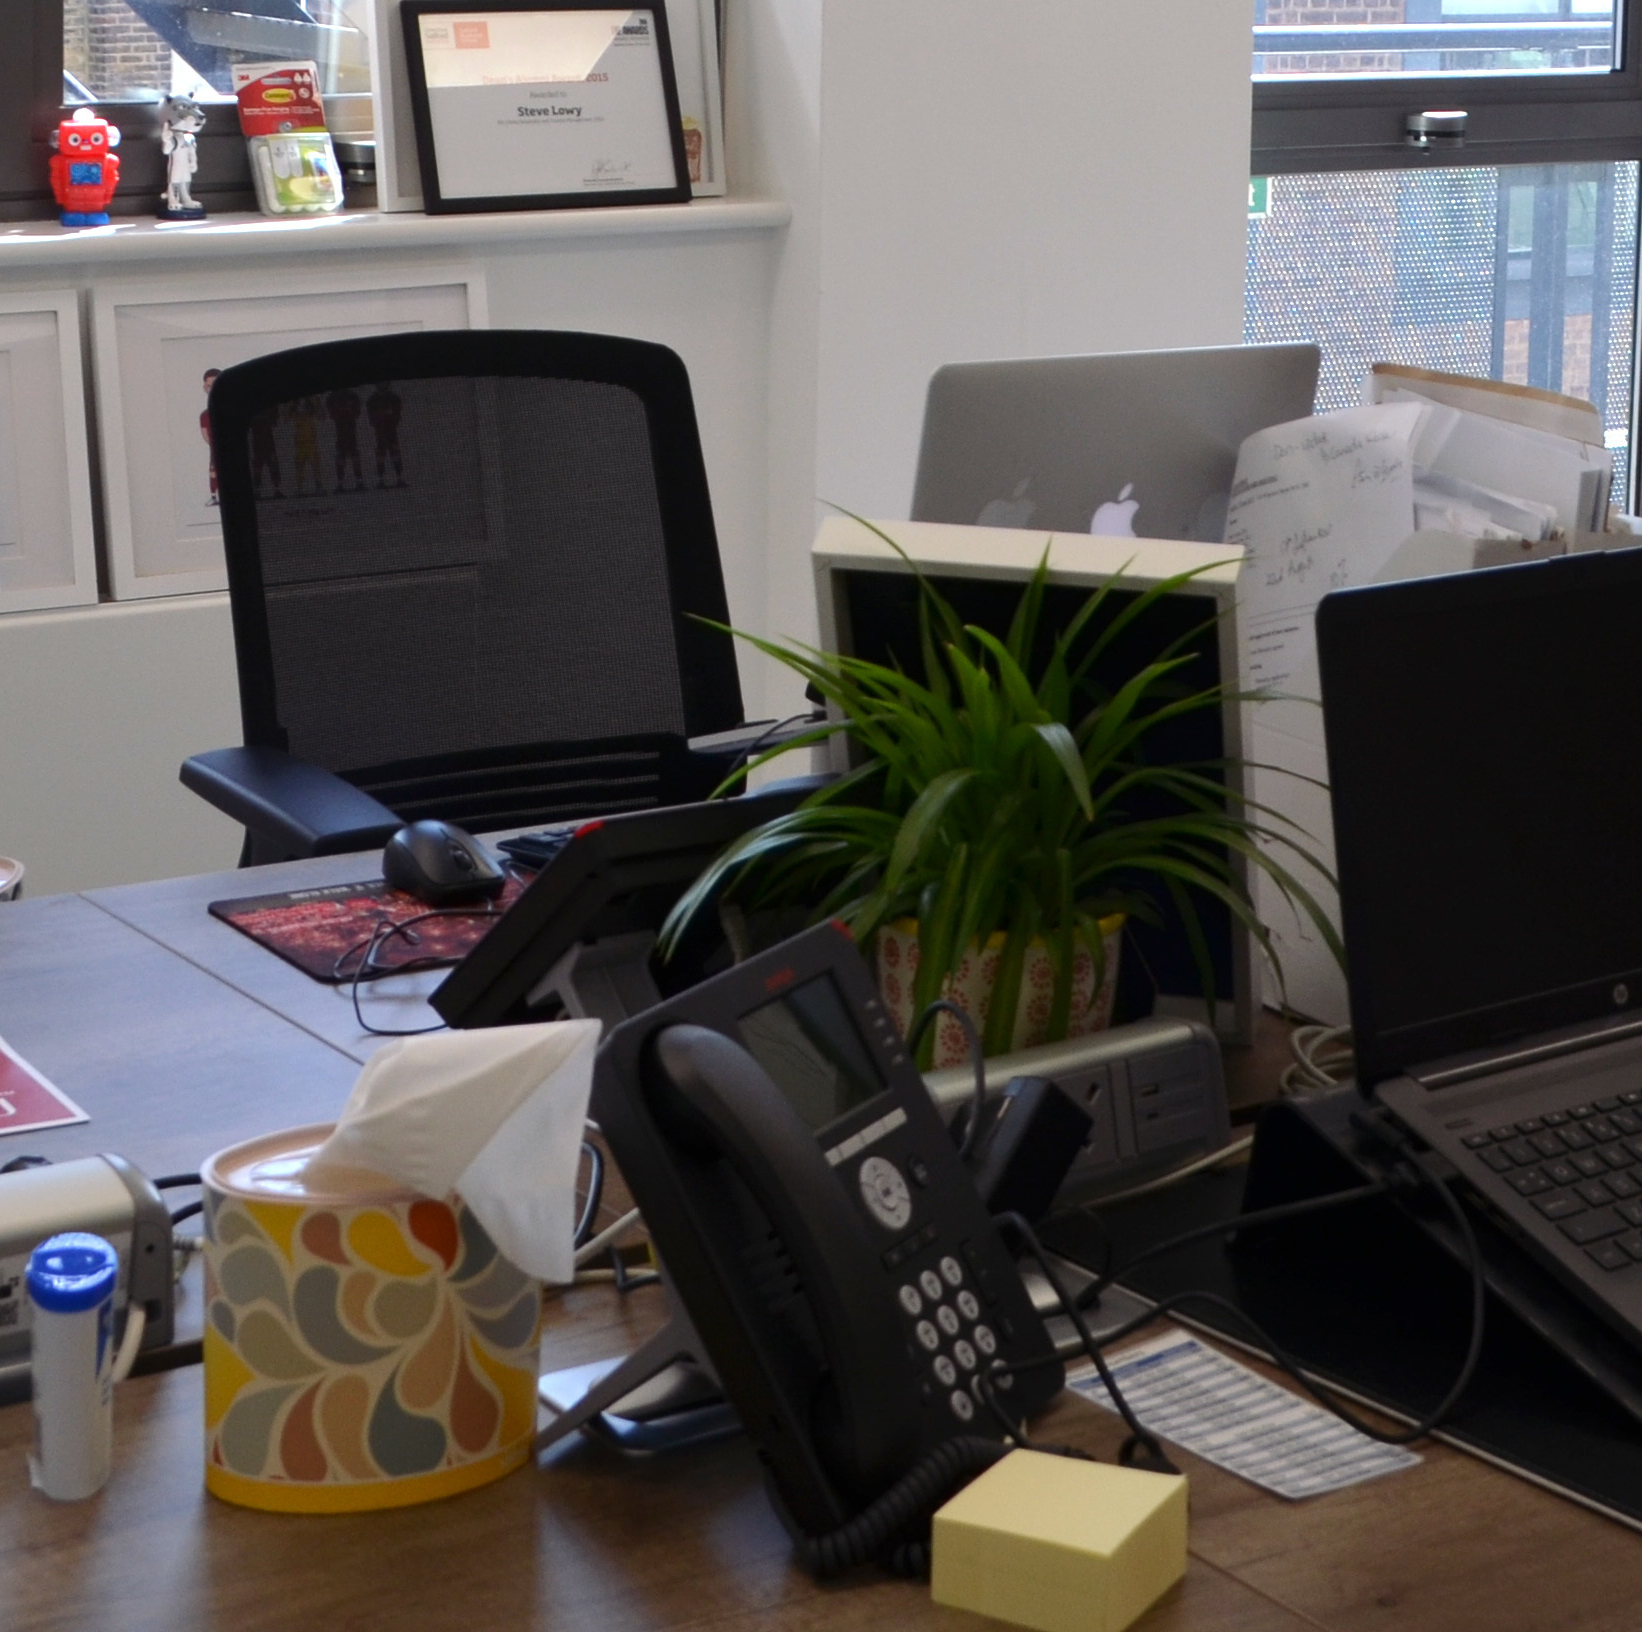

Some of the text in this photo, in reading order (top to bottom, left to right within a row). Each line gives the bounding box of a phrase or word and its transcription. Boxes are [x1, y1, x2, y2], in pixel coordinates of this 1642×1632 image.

[586, 72, 609, 83] 2015
[517, 105, 582, 117] Steve Lowy
